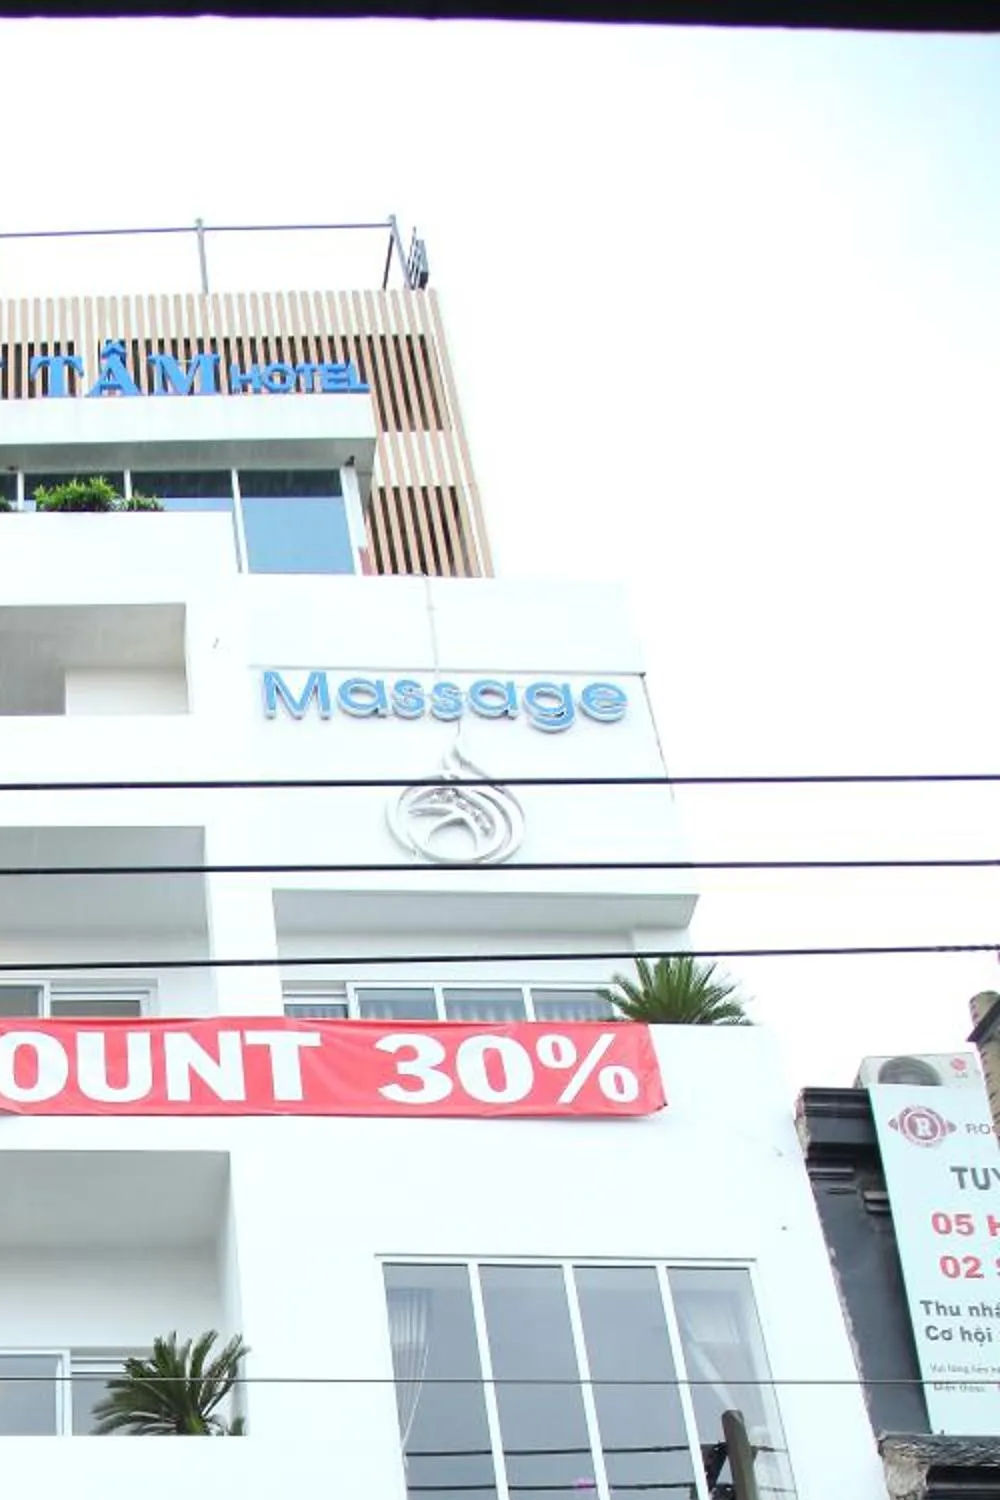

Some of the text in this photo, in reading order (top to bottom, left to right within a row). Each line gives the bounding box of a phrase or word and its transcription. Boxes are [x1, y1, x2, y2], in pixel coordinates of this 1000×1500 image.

[30, 340, 221, 397] TÂM
[230, 361, 371, 393] HOTEL
[263, 671, 629, 733] Massage
[375, 1033, 640, 1105] 30%
[931, 1212, 975, 1236] 05
[939, 1255, 985, 1279] 02
[919, 1299, 961, 1318] Thu
